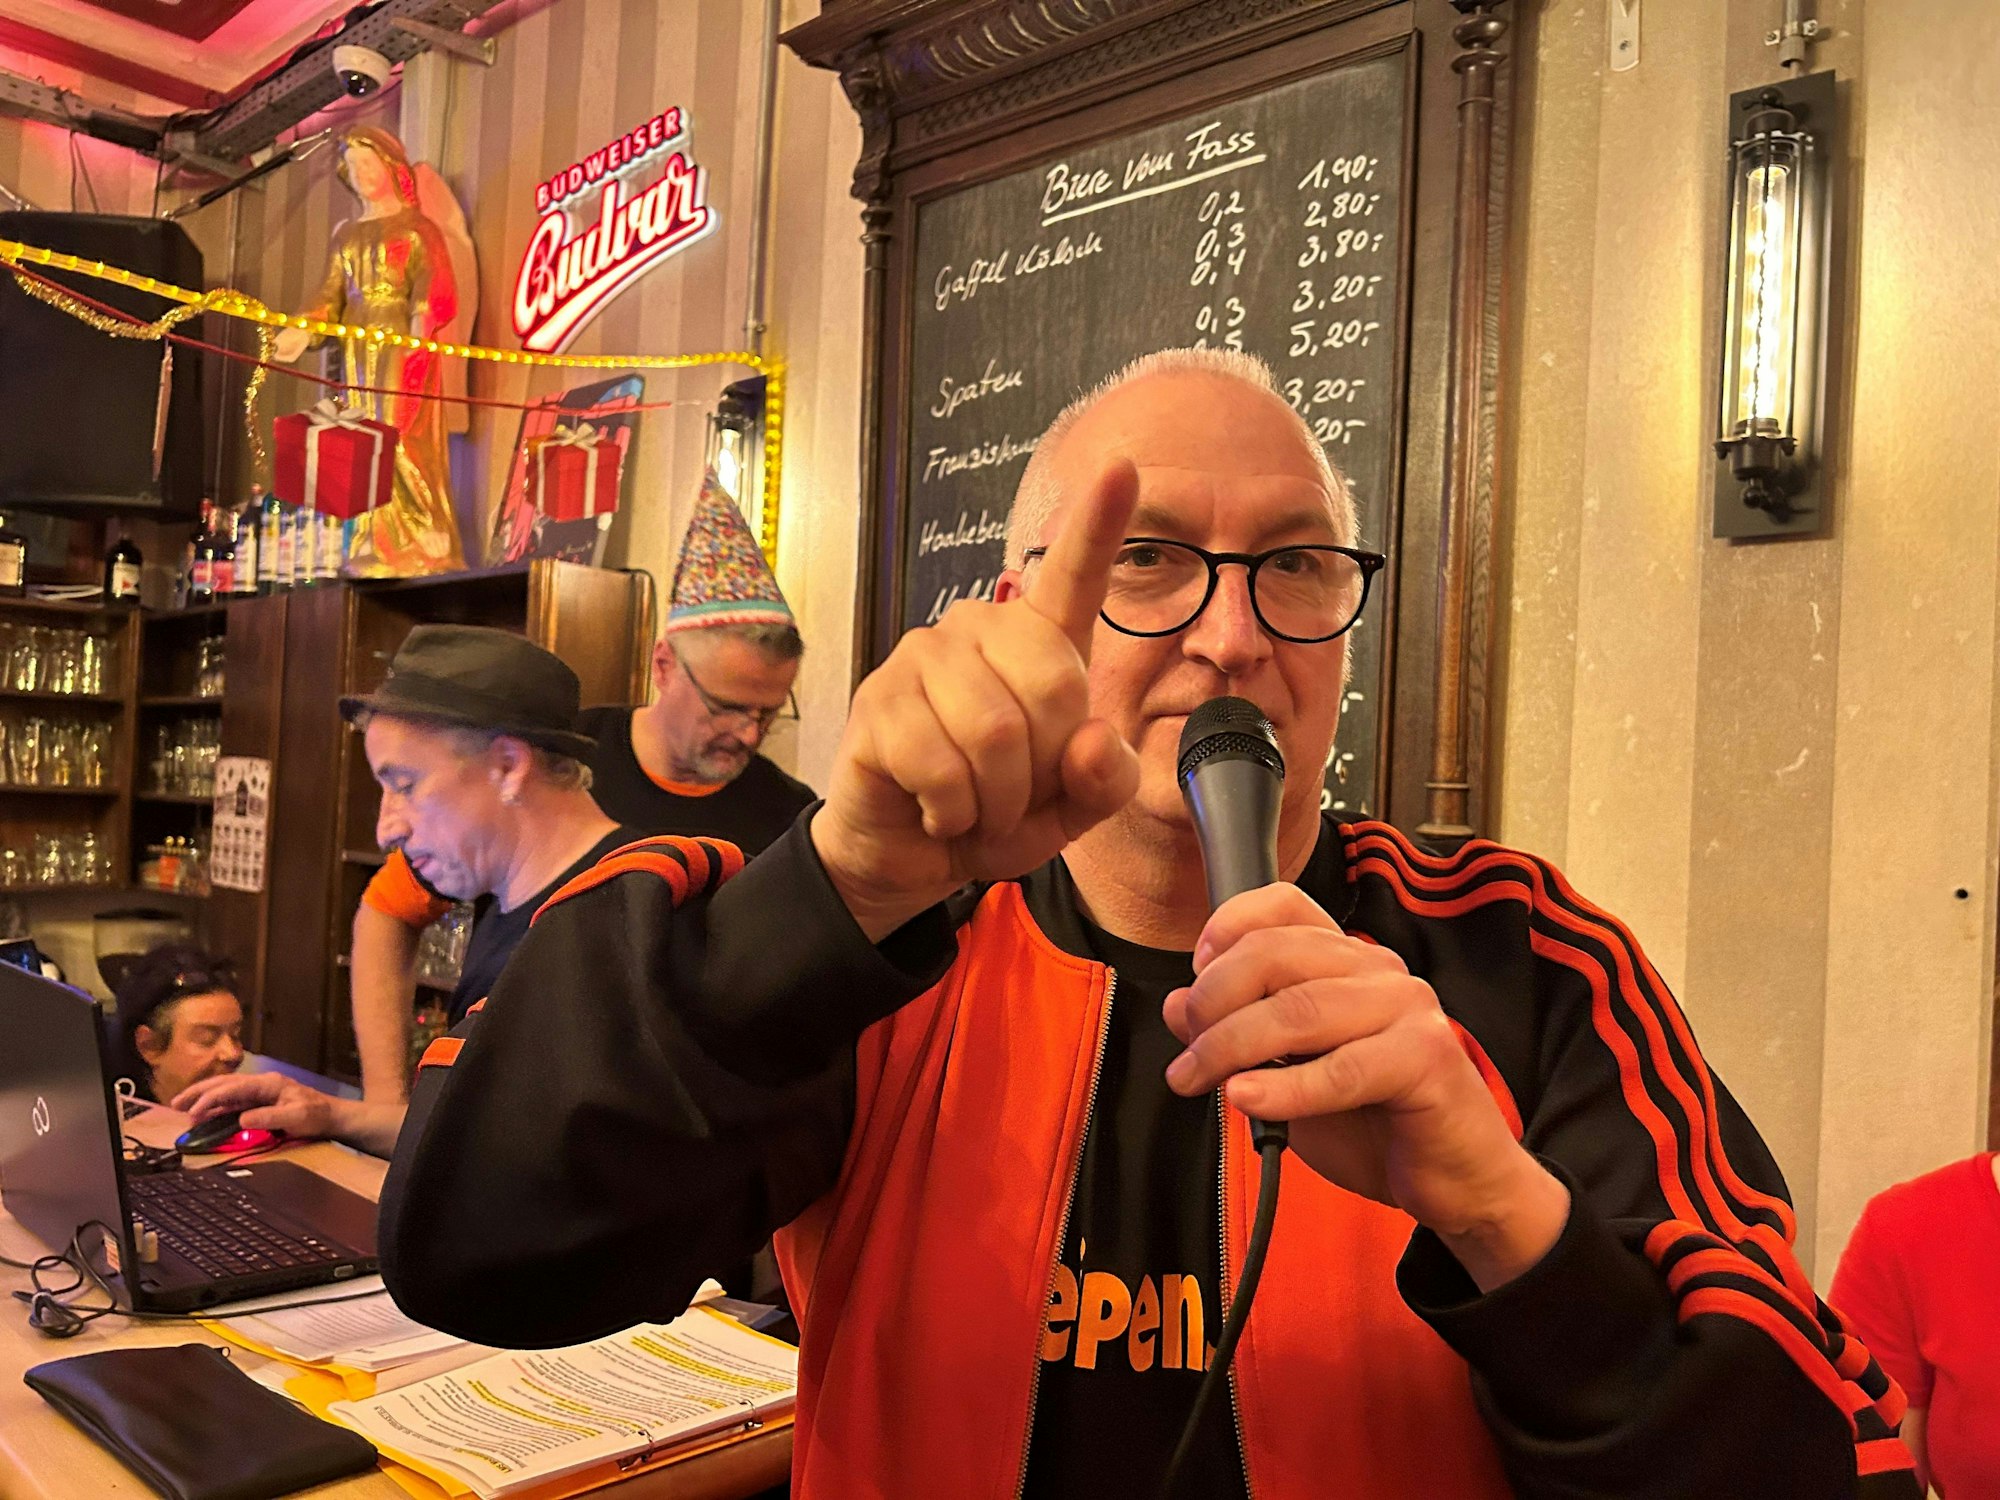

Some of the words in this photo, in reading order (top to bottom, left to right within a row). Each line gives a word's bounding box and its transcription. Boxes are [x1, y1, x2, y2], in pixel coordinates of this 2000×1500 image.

[535, 106, 682, 213] BUDWEISER
[1041, 163, 1114, 214] Biere
[1185, 121, 1257, 170] Fass
[1198, 190, 1246, 227] 0,2
[513, 153, 708, 345] Budvar
[1190, 248, 1246, 287] 0,4
[1195, 222, 1246, 264] 0,3
[934, 249, 1009, 311] Gaffel
[1195, 297, 1246, 334] 0,3
[930, 359, 1023, 418] Spaten
